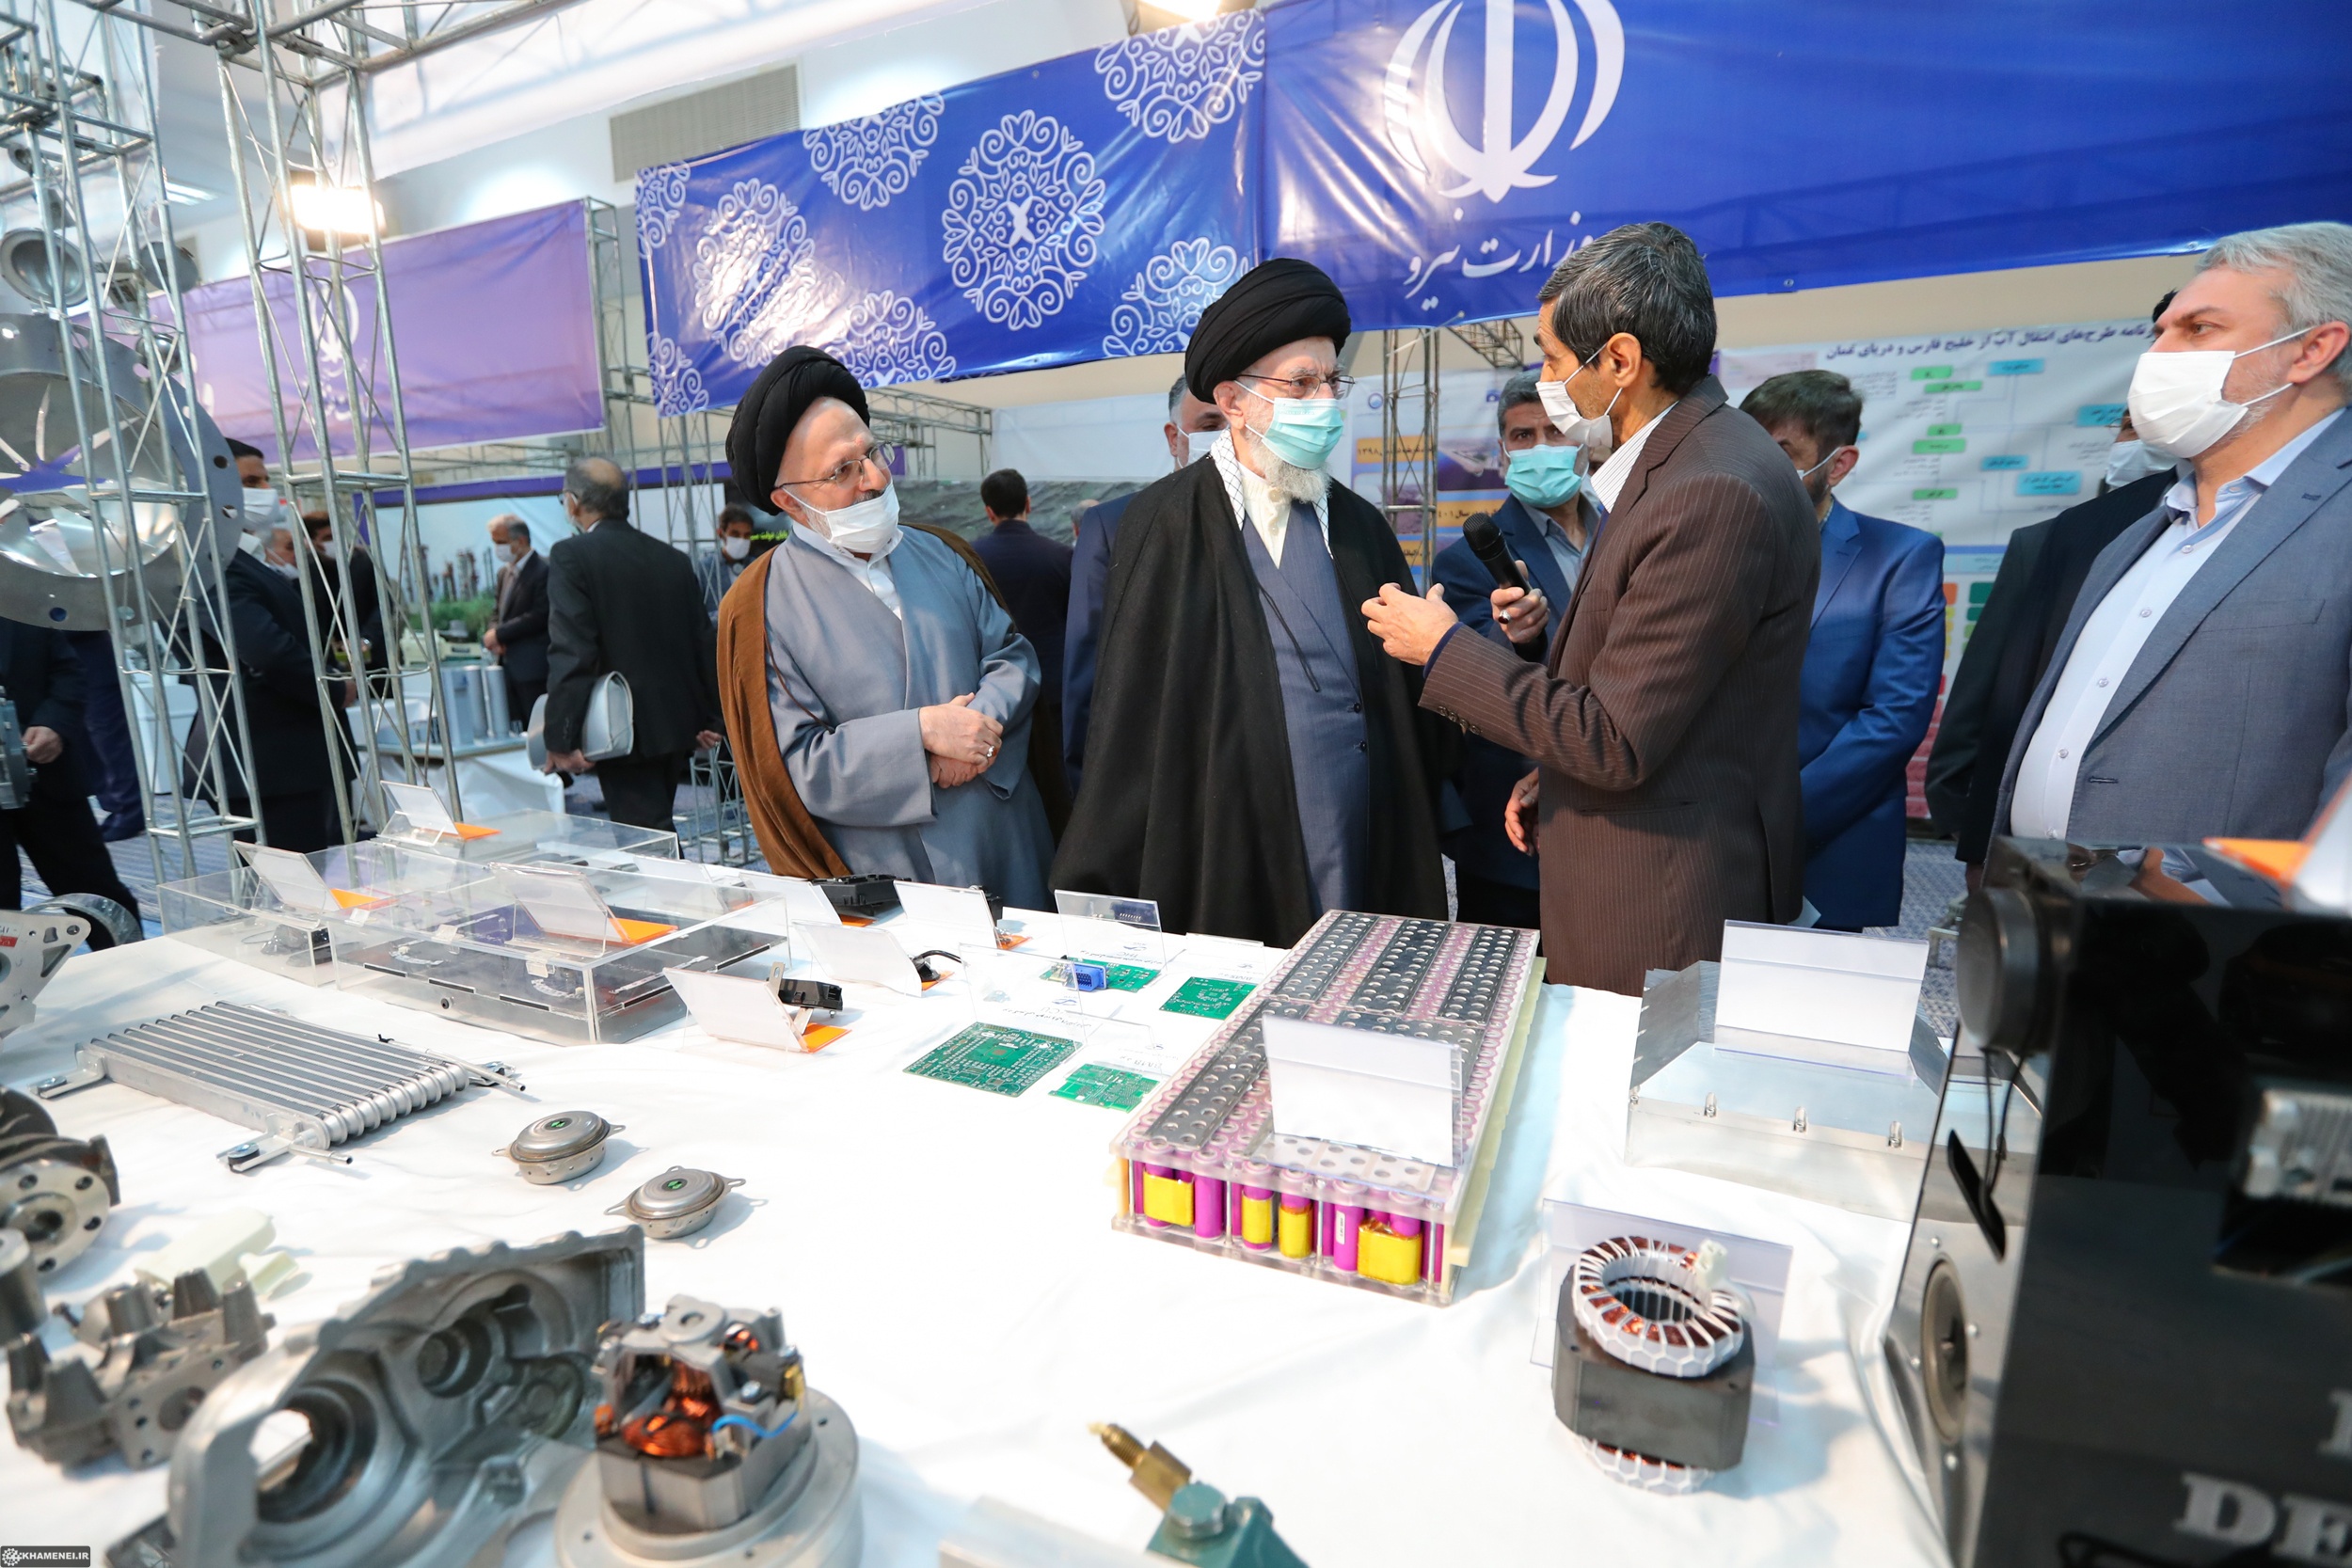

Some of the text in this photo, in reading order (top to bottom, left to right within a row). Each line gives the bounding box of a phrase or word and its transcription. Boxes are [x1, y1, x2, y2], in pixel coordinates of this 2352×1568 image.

[1402, 207, 1464, 311] نیرو
[2121, 323, 2156, 343] رنامه
[1826, 344, 1856, 360] عمان
[1857, 342, 1893, 358] دریای
[1906, 338, 1942, 355] فارس
[1944, 336, 1975, 353] خلیج
